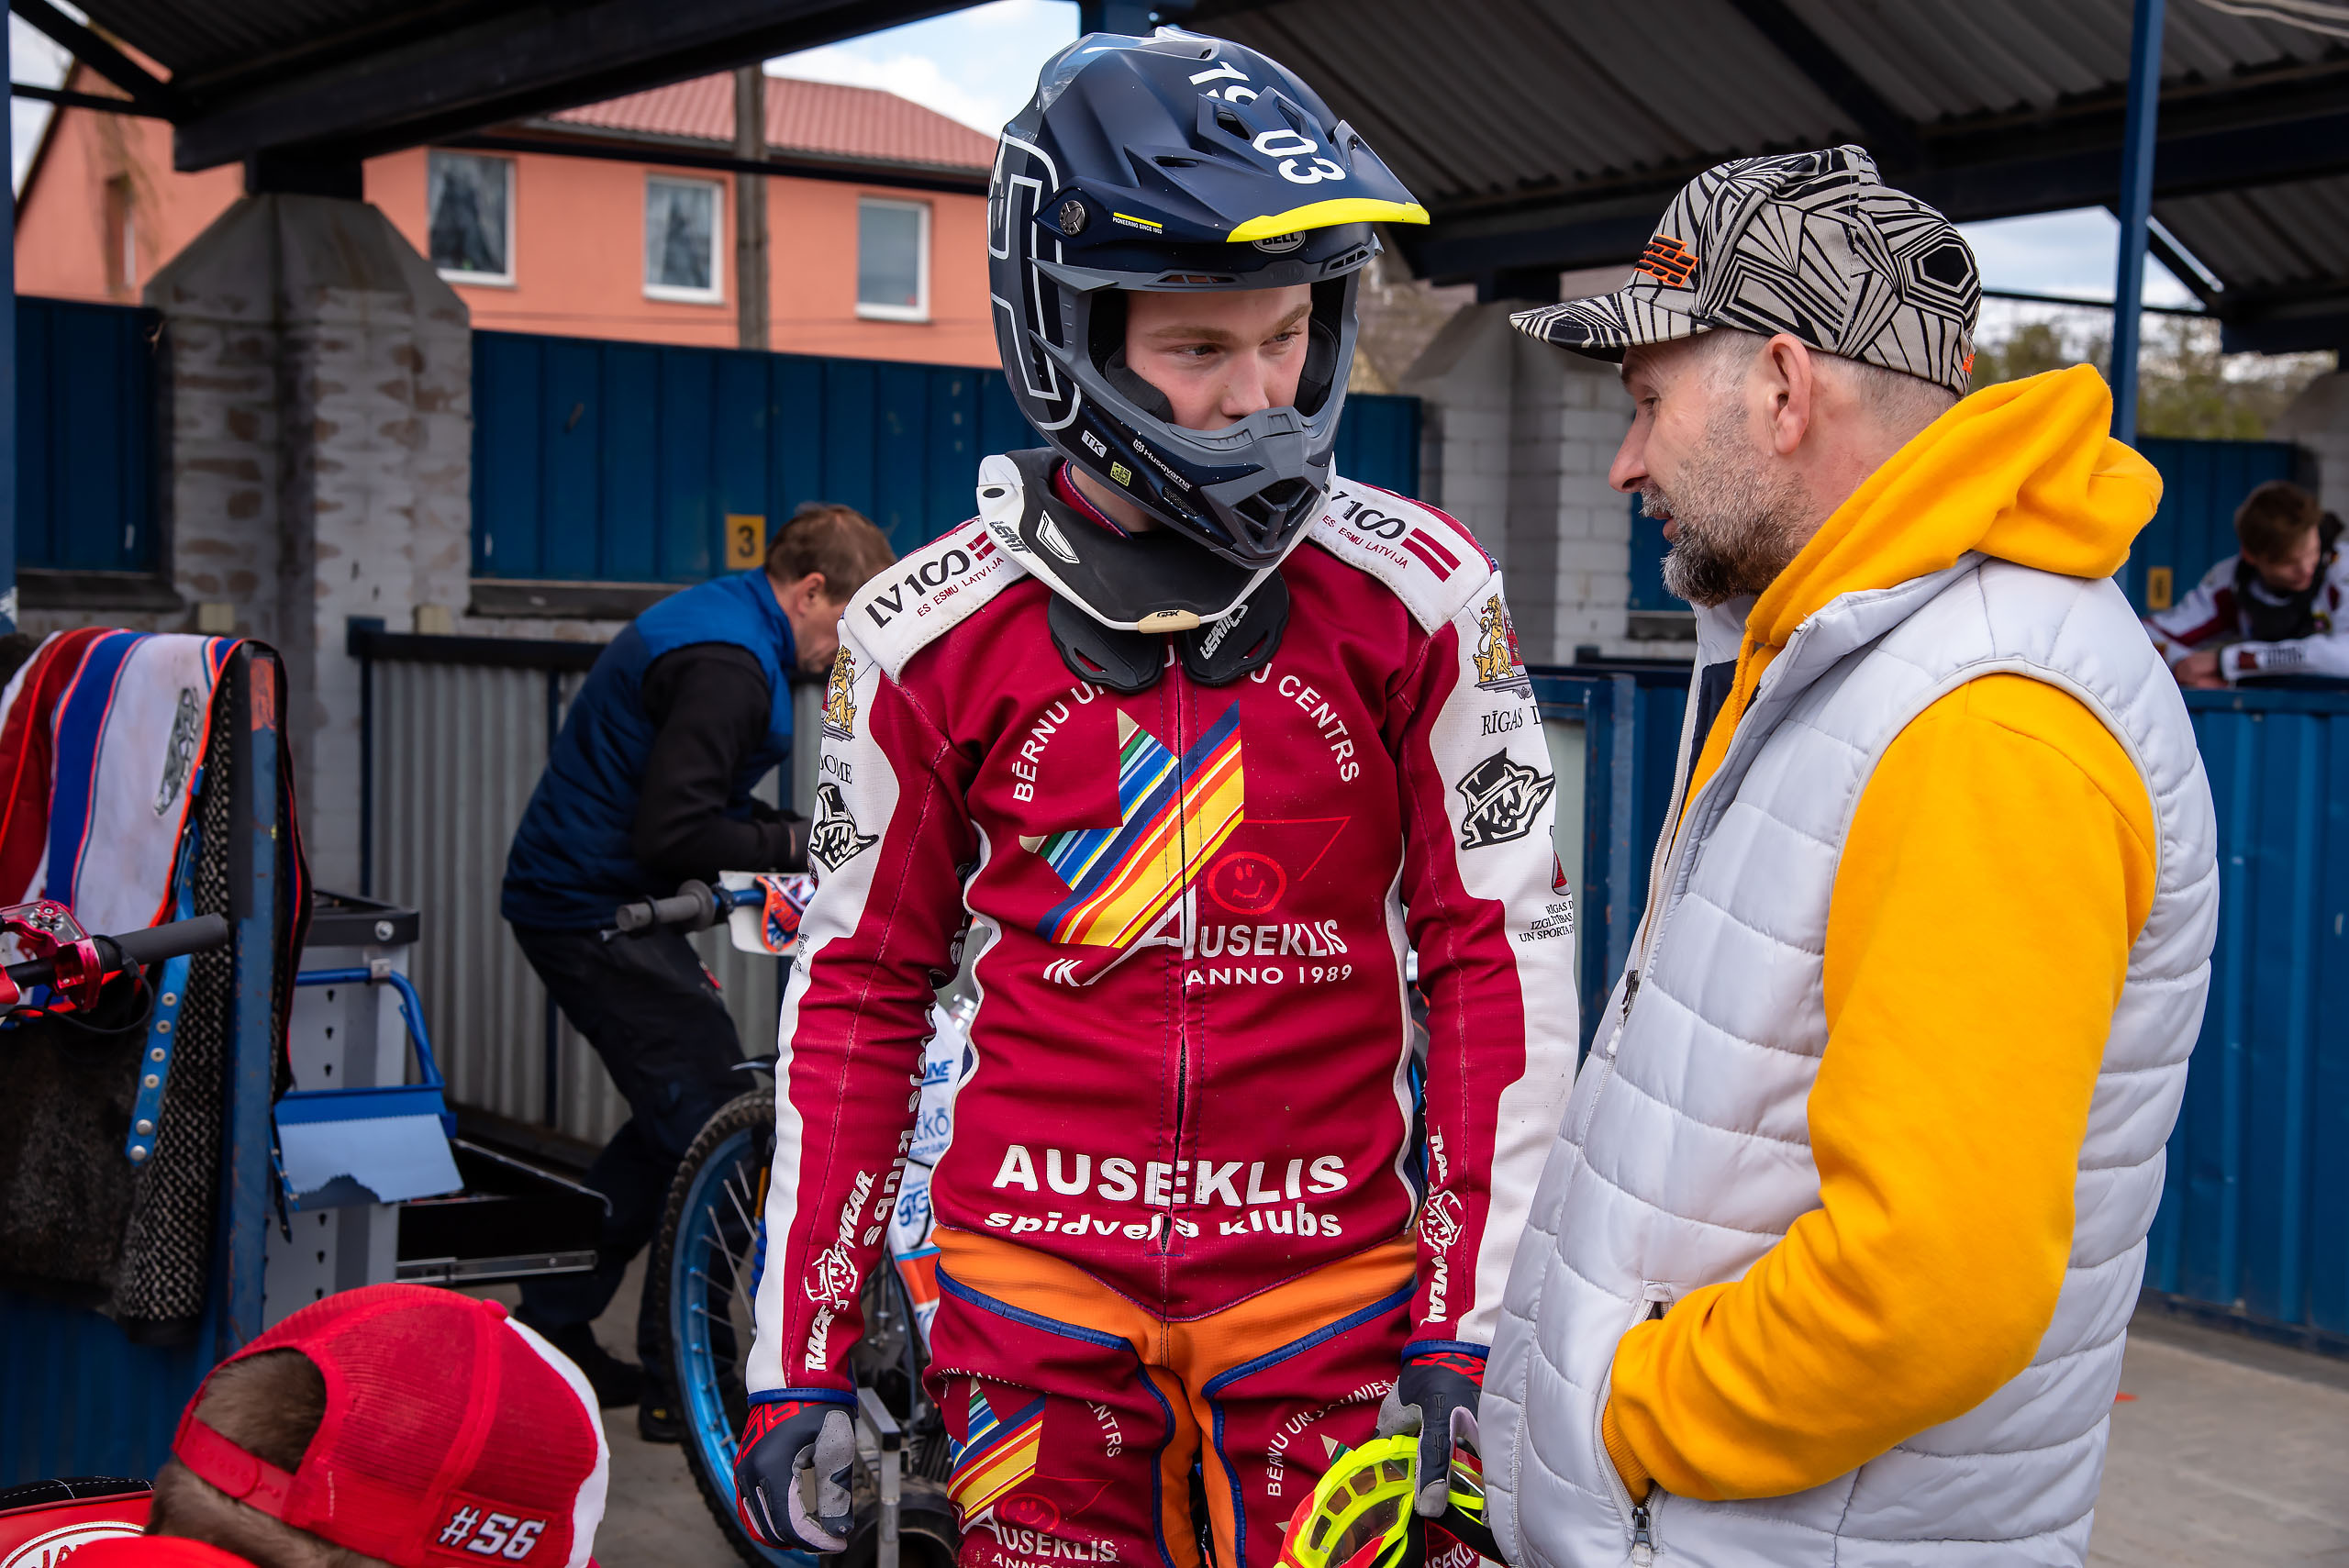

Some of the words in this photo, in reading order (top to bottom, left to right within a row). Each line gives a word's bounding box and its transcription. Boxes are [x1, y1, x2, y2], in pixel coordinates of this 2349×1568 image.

[1085, 432, 1103, 455] TK
[1143, 449, 1192, 490] Husqvarna
[737, 525, 754, 558] 3
[1322, 515, 1336, 528] ES
[1338, 528, 1364, 546] ESMU
[1365, 541, 1408, 569] LATVIJA
[918, 603, 931, 617] ES
[932, 584, 960, 606] ESMU
[961, 556, 1005, 587] LATVIJA
[1011, 700, 1070, 803] BĒRNU
[1278, 674, 1360, 782] CENTRS
[1481, 707, 1523, 737] RĪGAS
[1082, 884, 1348, 986] AUSEKLIS
[1519, 931, 1535, 942] UN
[1537, 926, 1570, 940] SPORTA
[1186, 966, 1285, 986] ANNO
[1298, 963, 1353, 984] 1989
[992, 1144, 1349, 1207] AUSEKLIS
[1219, 1202, 1342, 1238] klubs
[805, 1304, 836, 1373] RACE
[839, 1170, 877, 1249] WEAR
[1266, 1431, 1289, 1497] BĒRNU
[439, 1506, 547, 1560] #56
[962, 1505, 1117, 1562] AUSEKLIS
